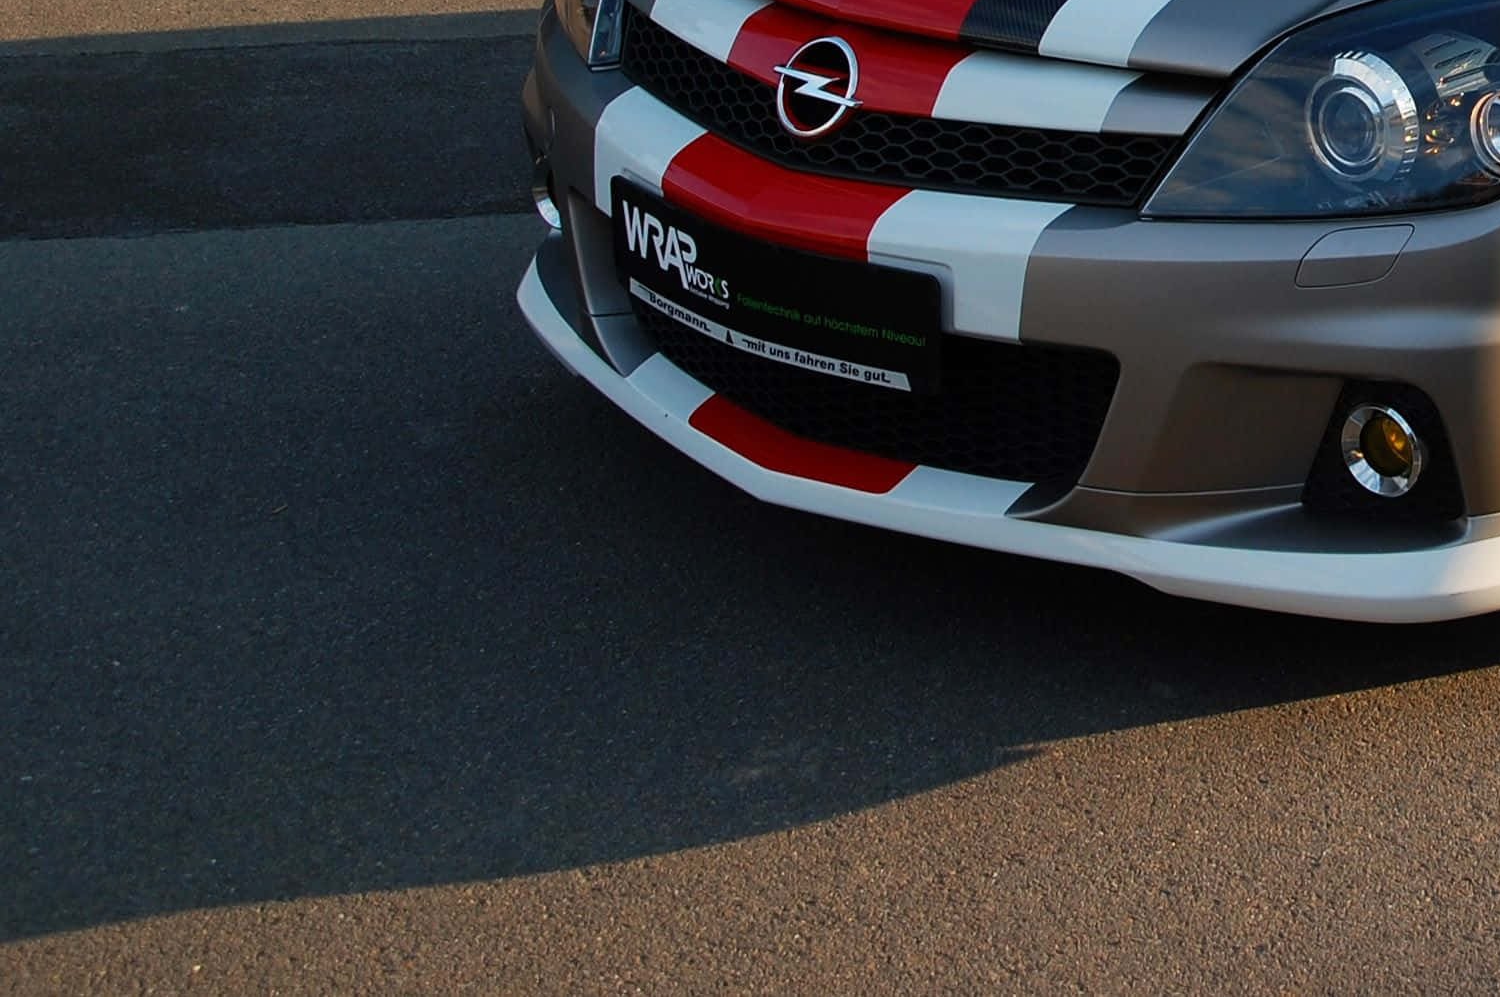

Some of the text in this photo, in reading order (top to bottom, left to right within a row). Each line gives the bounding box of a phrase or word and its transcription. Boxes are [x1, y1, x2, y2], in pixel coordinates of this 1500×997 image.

[622, 199, 697, 290] WRAP
[769, 346, 791, 360] uns
[794, 352, 836, 372] fahren
[839, 362, 860, 376] Sie
